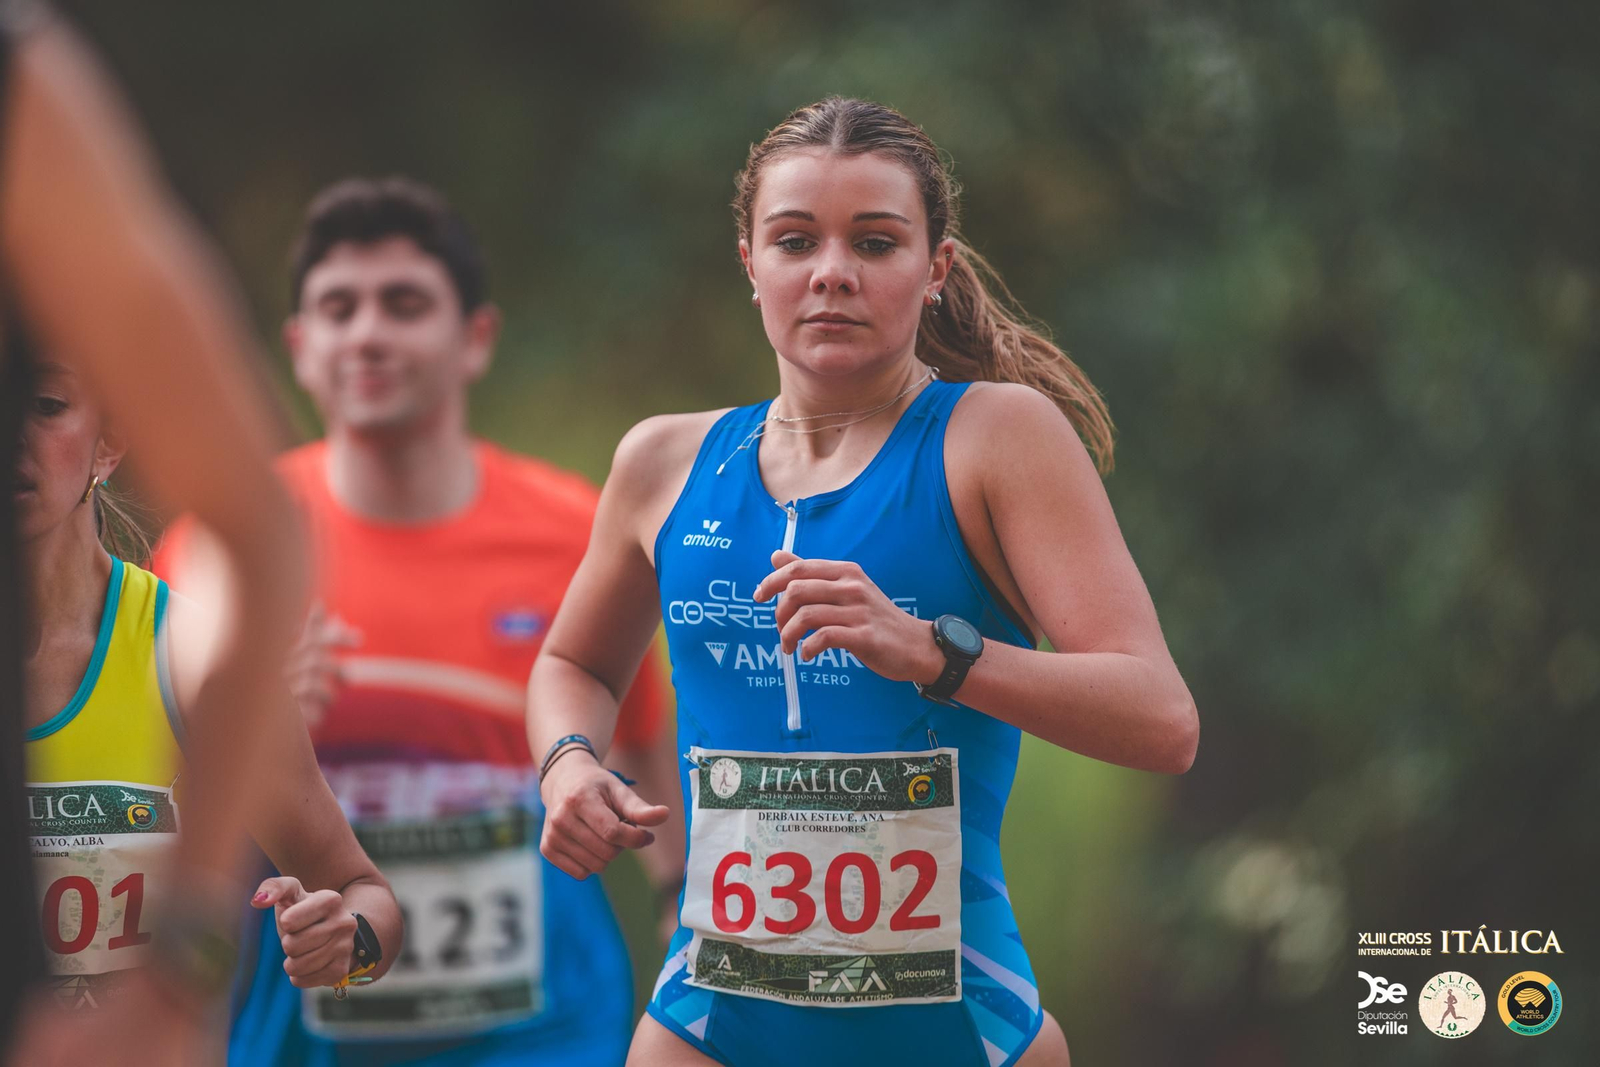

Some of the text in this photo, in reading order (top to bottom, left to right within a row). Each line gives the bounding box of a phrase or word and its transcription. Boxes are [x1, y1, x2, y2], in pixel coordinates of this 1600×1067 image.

[683, 534, 732, 549] amura
[708, 579, 777, 604] CL
[813, 673, 851, 686] ZERO
[758, 761, 888, 793] ITÁLICA
[27, 793, 107, 820] LICA
[69, 818, 108, 826] COUNTRY
[758, 811, 885, 823] DERBAIX ESTEVE, ANA
[775, 824, 866, 833] CLUB CORREDORES
[72, 836, 105, 846] ALBA
[711, 849, 941, 935] 6302
[42, 872, 152, 955] 01
[903, 968, 946, 979] docunova
[740, 984, 786, 999] FEDERACIÓN
[788, 993, 832, 1003] ANDALUZA
[850, 993, 894, 1003] ATLETISMO
